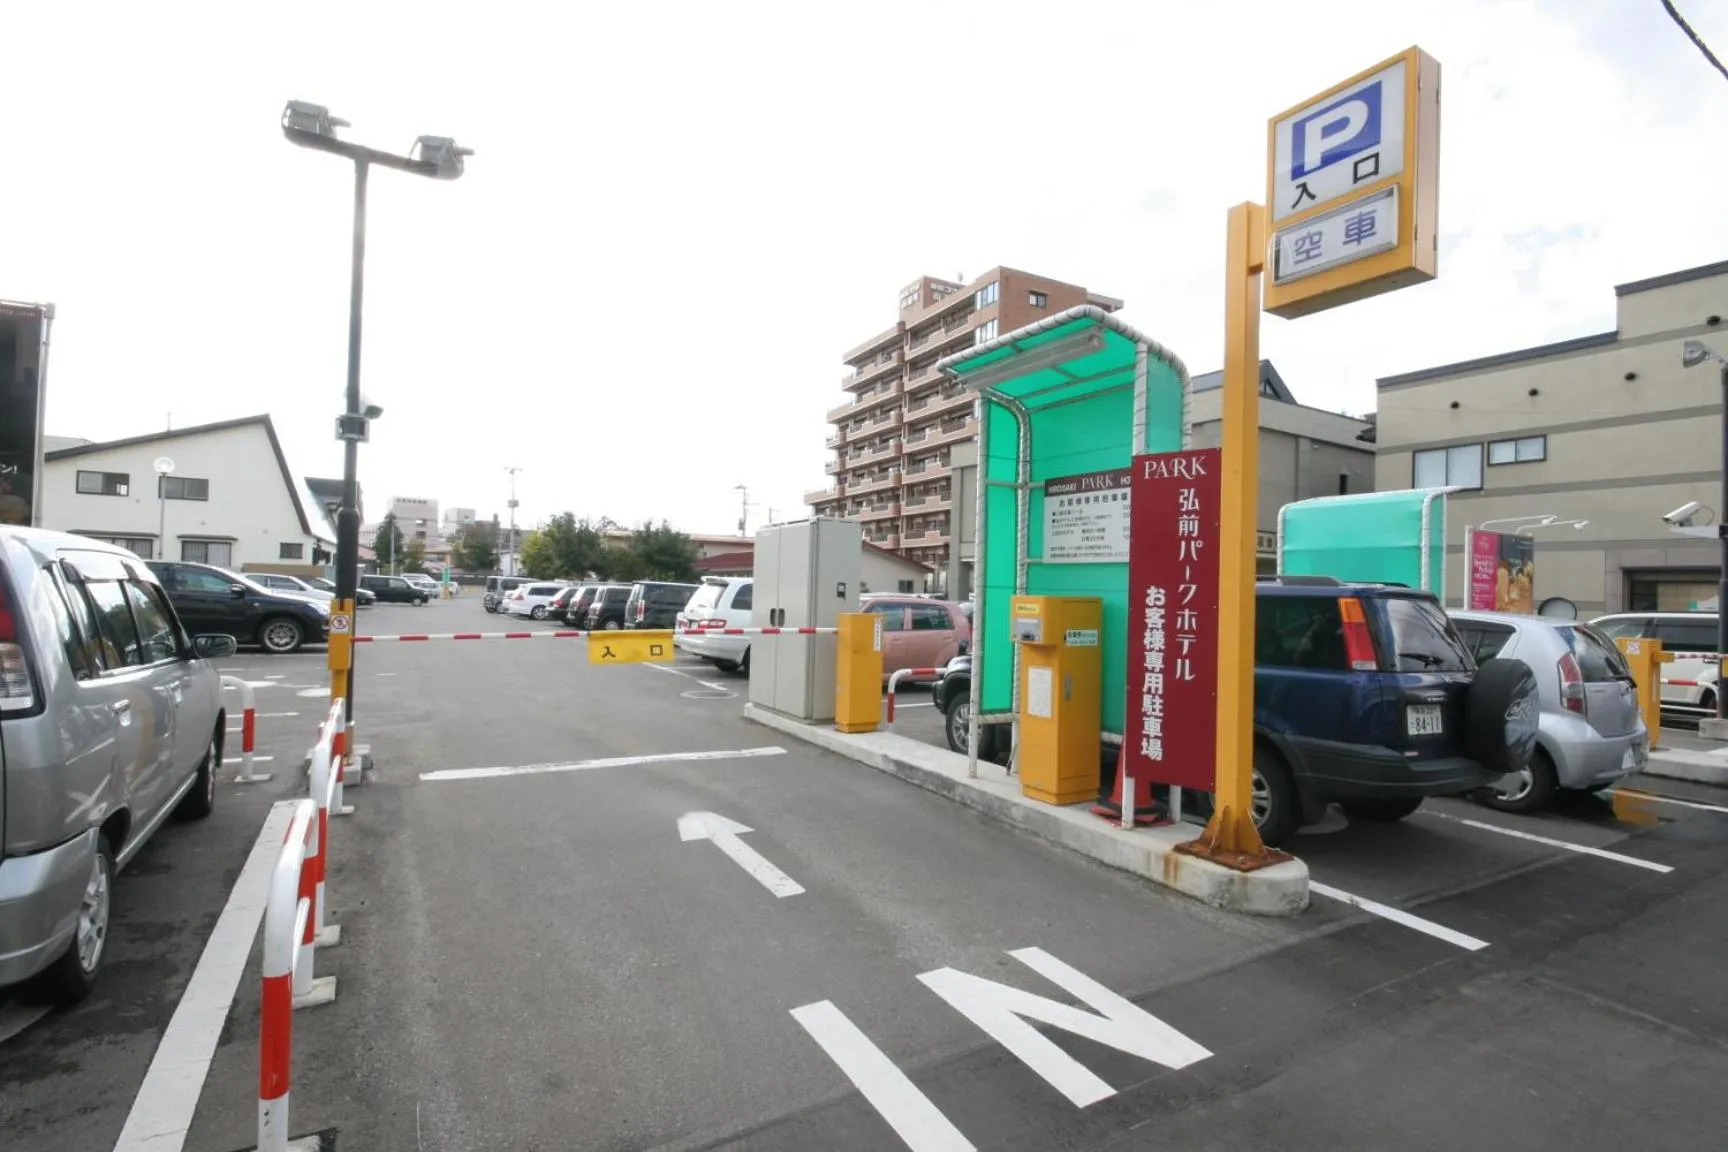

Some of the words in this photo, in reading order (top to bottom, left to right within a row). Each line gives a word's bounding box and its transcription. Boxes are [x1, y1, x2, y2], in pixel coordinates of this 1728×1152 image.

[1304, 99, 1369, 172] P
[1291, 152, 1380, 210] 入口
[1293, 208, 1378, 265] 空車
[1081, 474, 1114, 490] PARK
[1144, 456, 1207, 479] PARK
[1176, 487, 1204, 681] 弘前パークホテル
[601, 644, 664, 659] 入口
[1141, 584, 1166, 762] お客様専用駐車場
